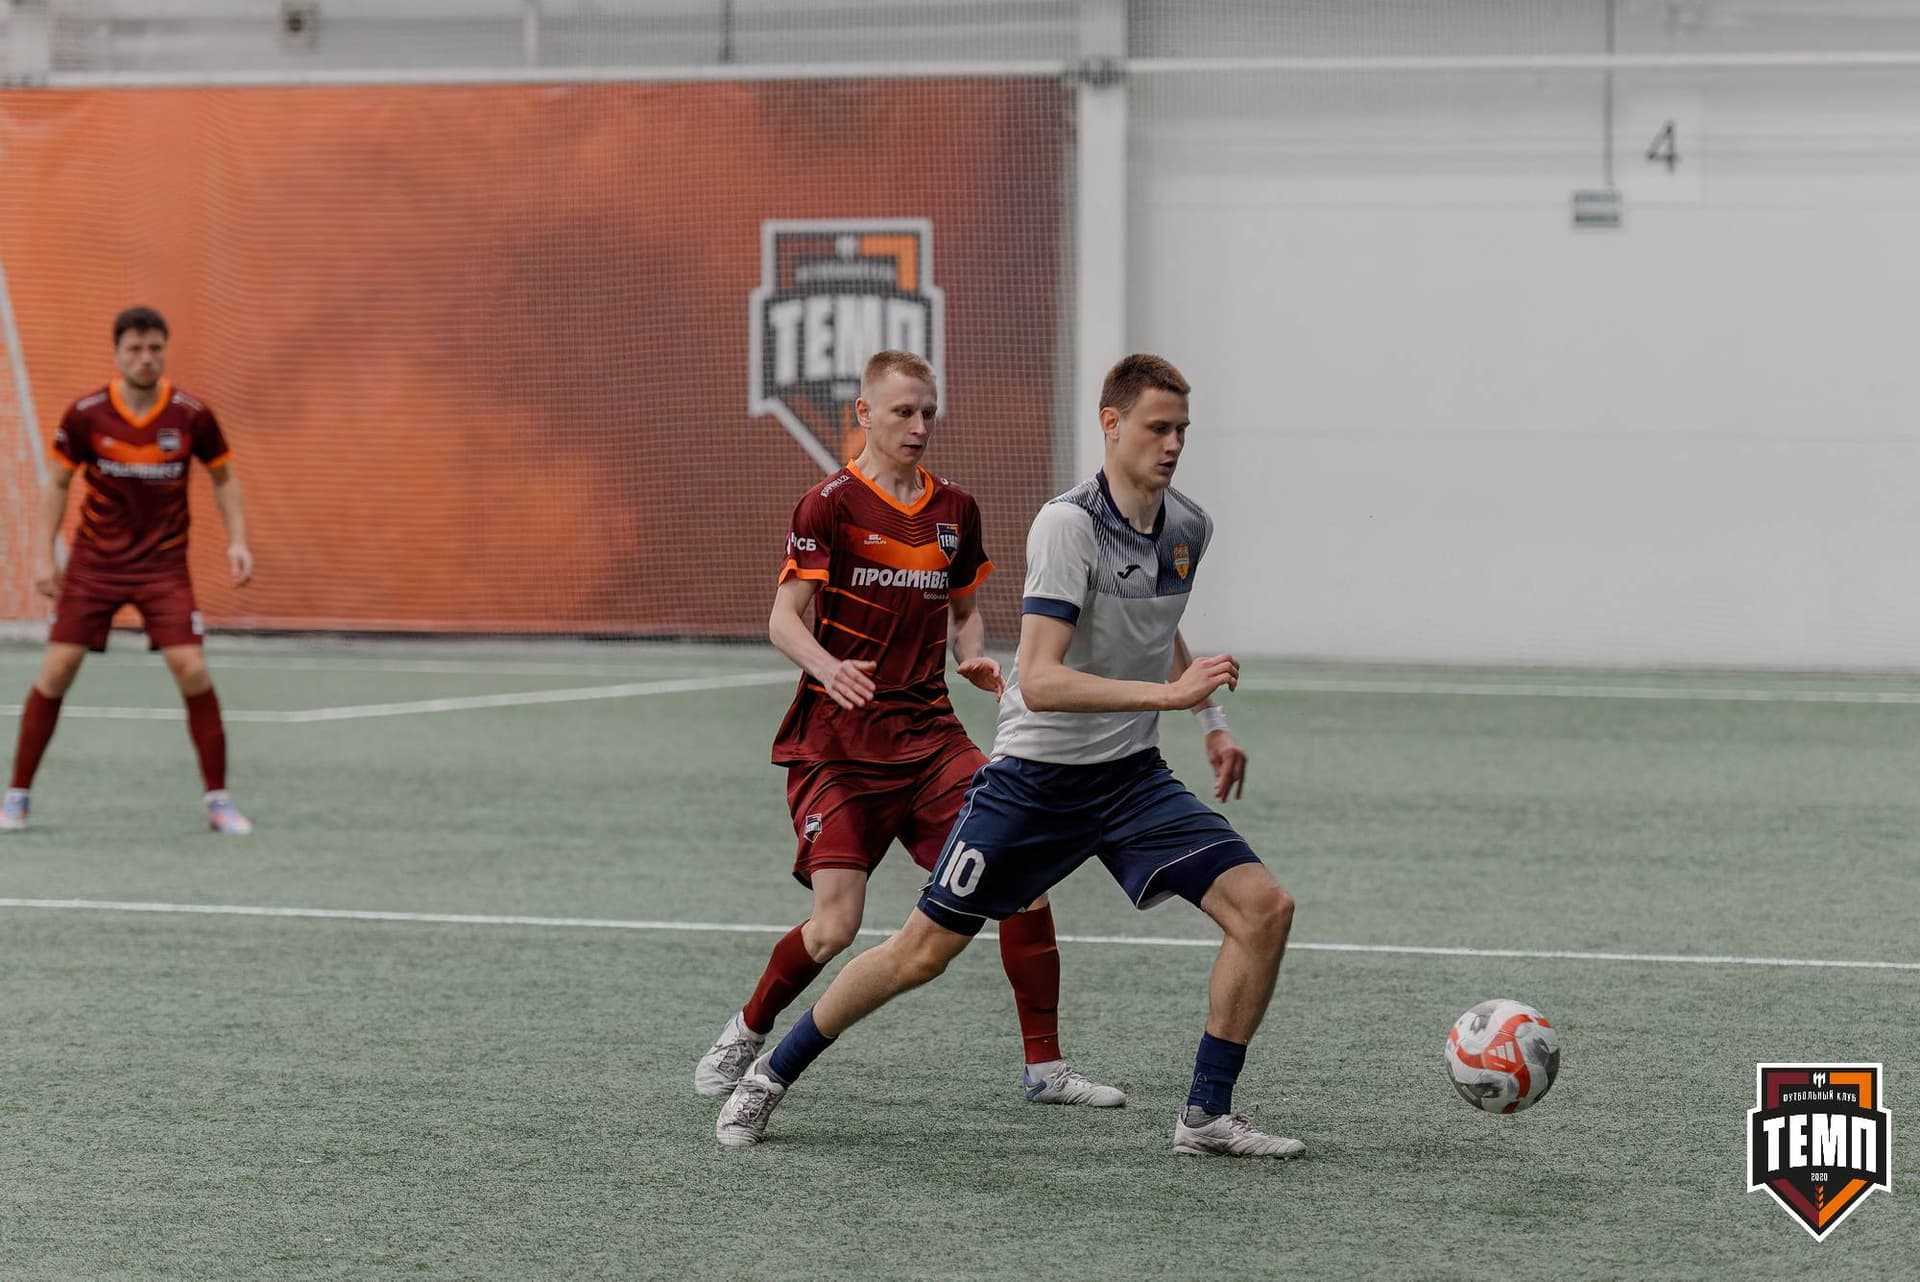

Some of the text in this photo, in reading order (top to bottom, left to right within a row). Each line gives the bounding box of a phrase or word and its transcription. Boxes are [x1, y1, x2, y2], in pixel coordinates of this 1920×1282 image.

[1645, 118, 1682, 173] 4
[769, 295, 928, 386] ТЕМП
[939, 841, 986, 897] 10
